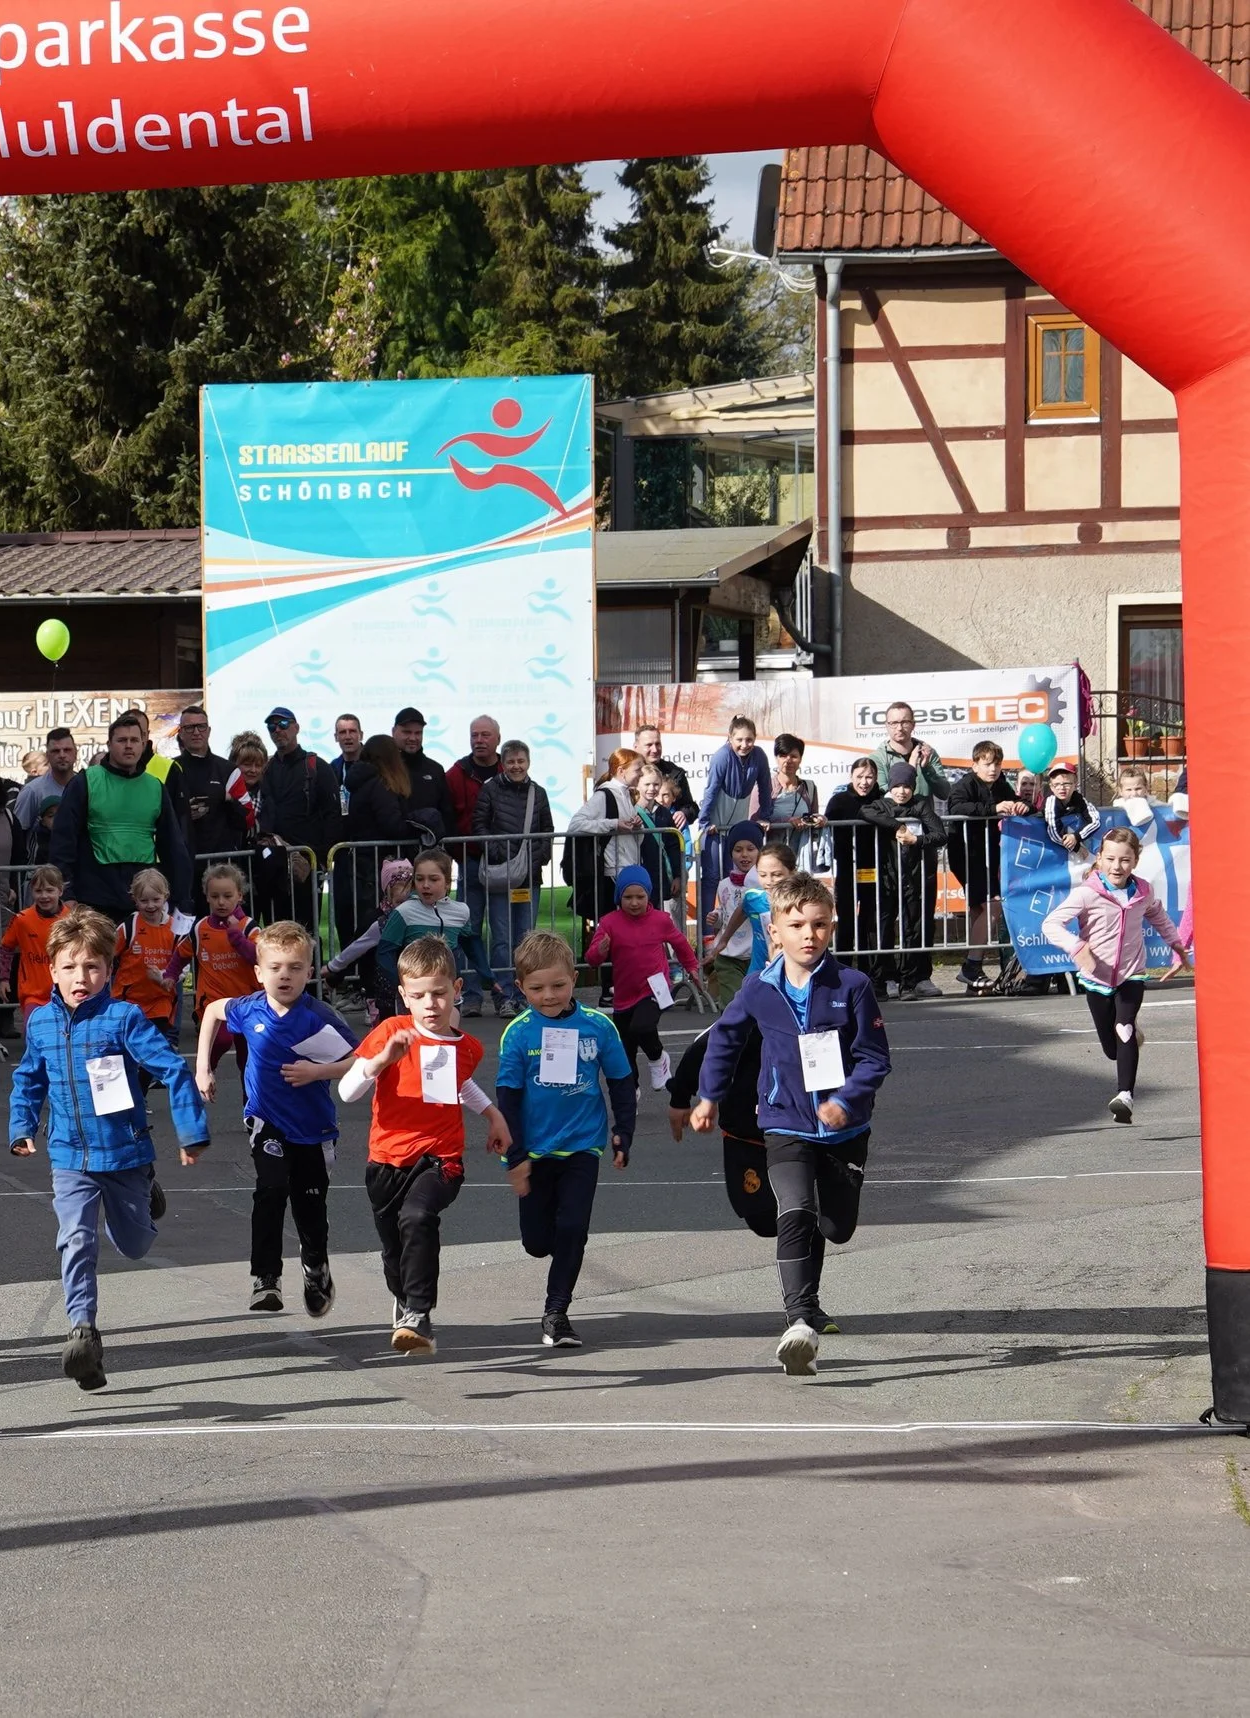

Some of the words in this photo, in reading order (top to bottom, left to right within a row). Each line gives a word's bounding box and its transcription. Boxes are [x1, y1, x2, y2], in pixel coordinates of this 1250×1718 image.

[239, 441, 409, 466] STRASSENLAUF
[239, 481, 412, 502] SCHÖNBACH
[961, 724, 1019, 734] Ersatzteilprofi
